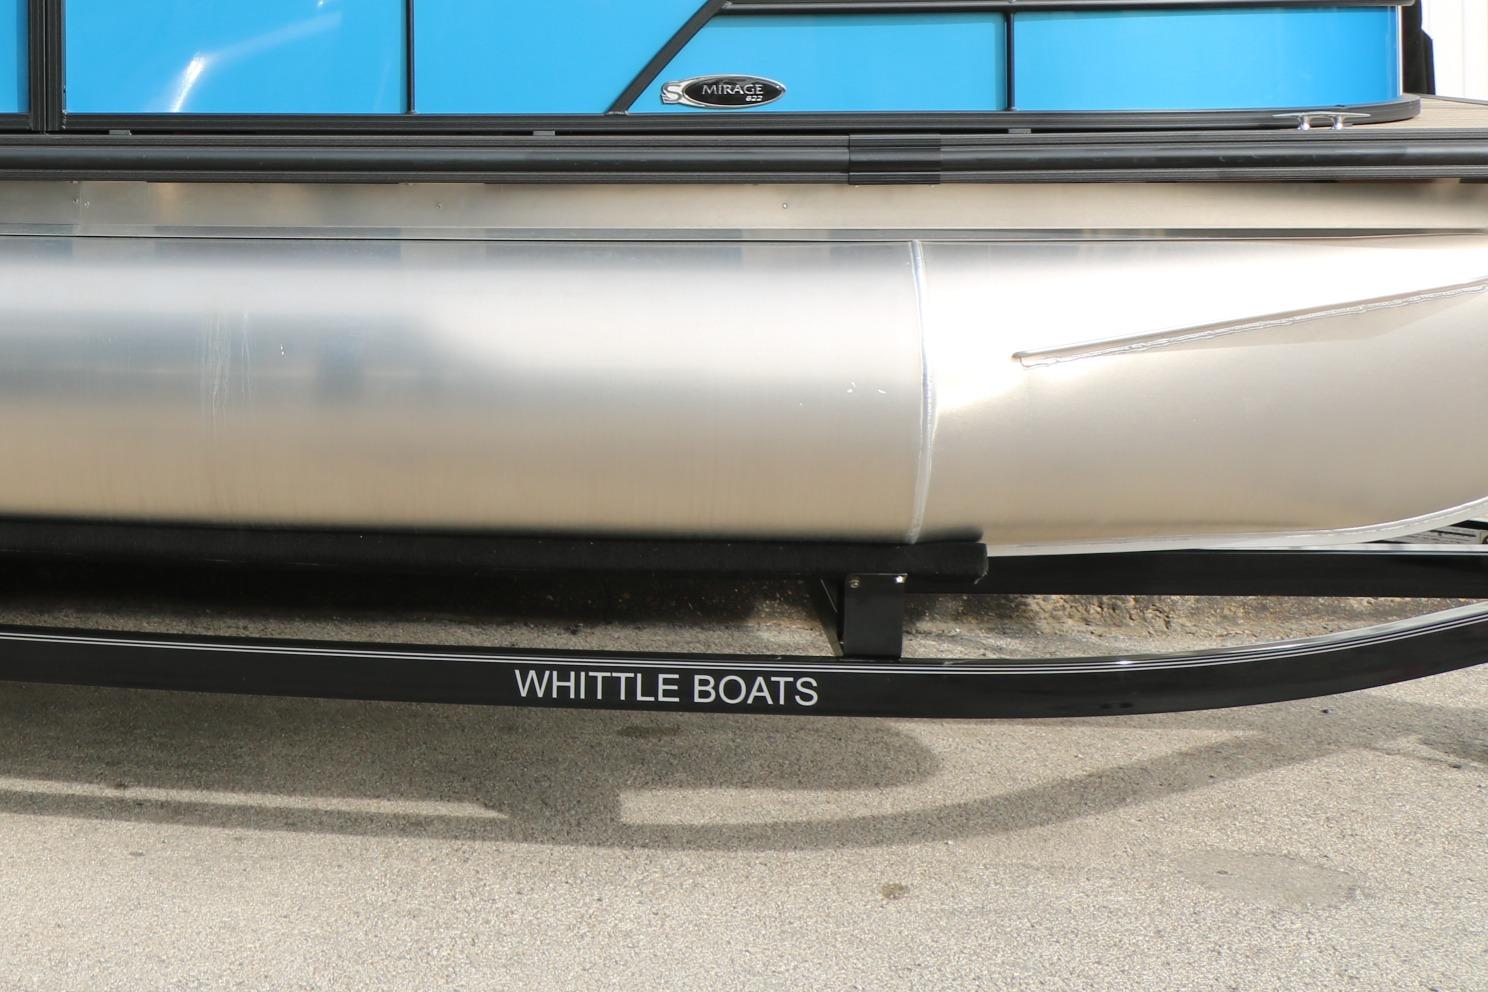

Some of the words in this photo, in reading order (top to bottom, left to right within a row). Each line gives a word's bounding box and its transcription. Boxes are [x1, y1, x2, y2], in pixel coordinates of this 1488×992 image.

[701, 84, 765, 95] MIRAGE
[514, 669, 680, 703] WHITTLE
[693, 674, 819, 706] BOATS
